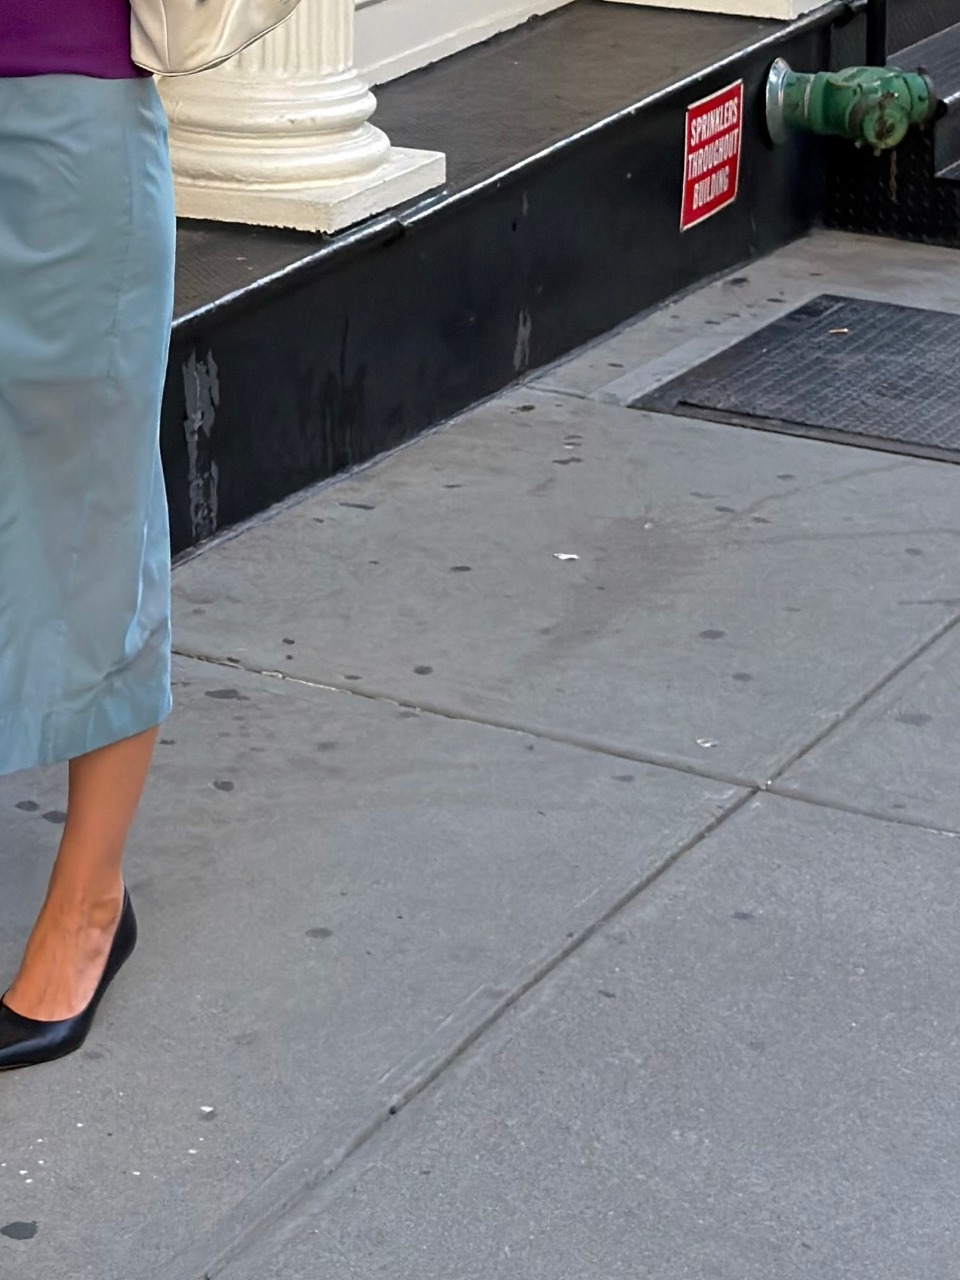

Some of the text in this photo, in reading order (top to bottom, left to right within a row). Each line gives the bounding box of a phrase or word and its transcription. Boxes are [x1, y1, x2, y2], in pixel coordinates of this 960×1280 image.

[690, 96, 738, 147] SPRINKLERS
[687, 128, 739, 181] THROUGHOUT
[692, 165, 730, 210] BUILDING
